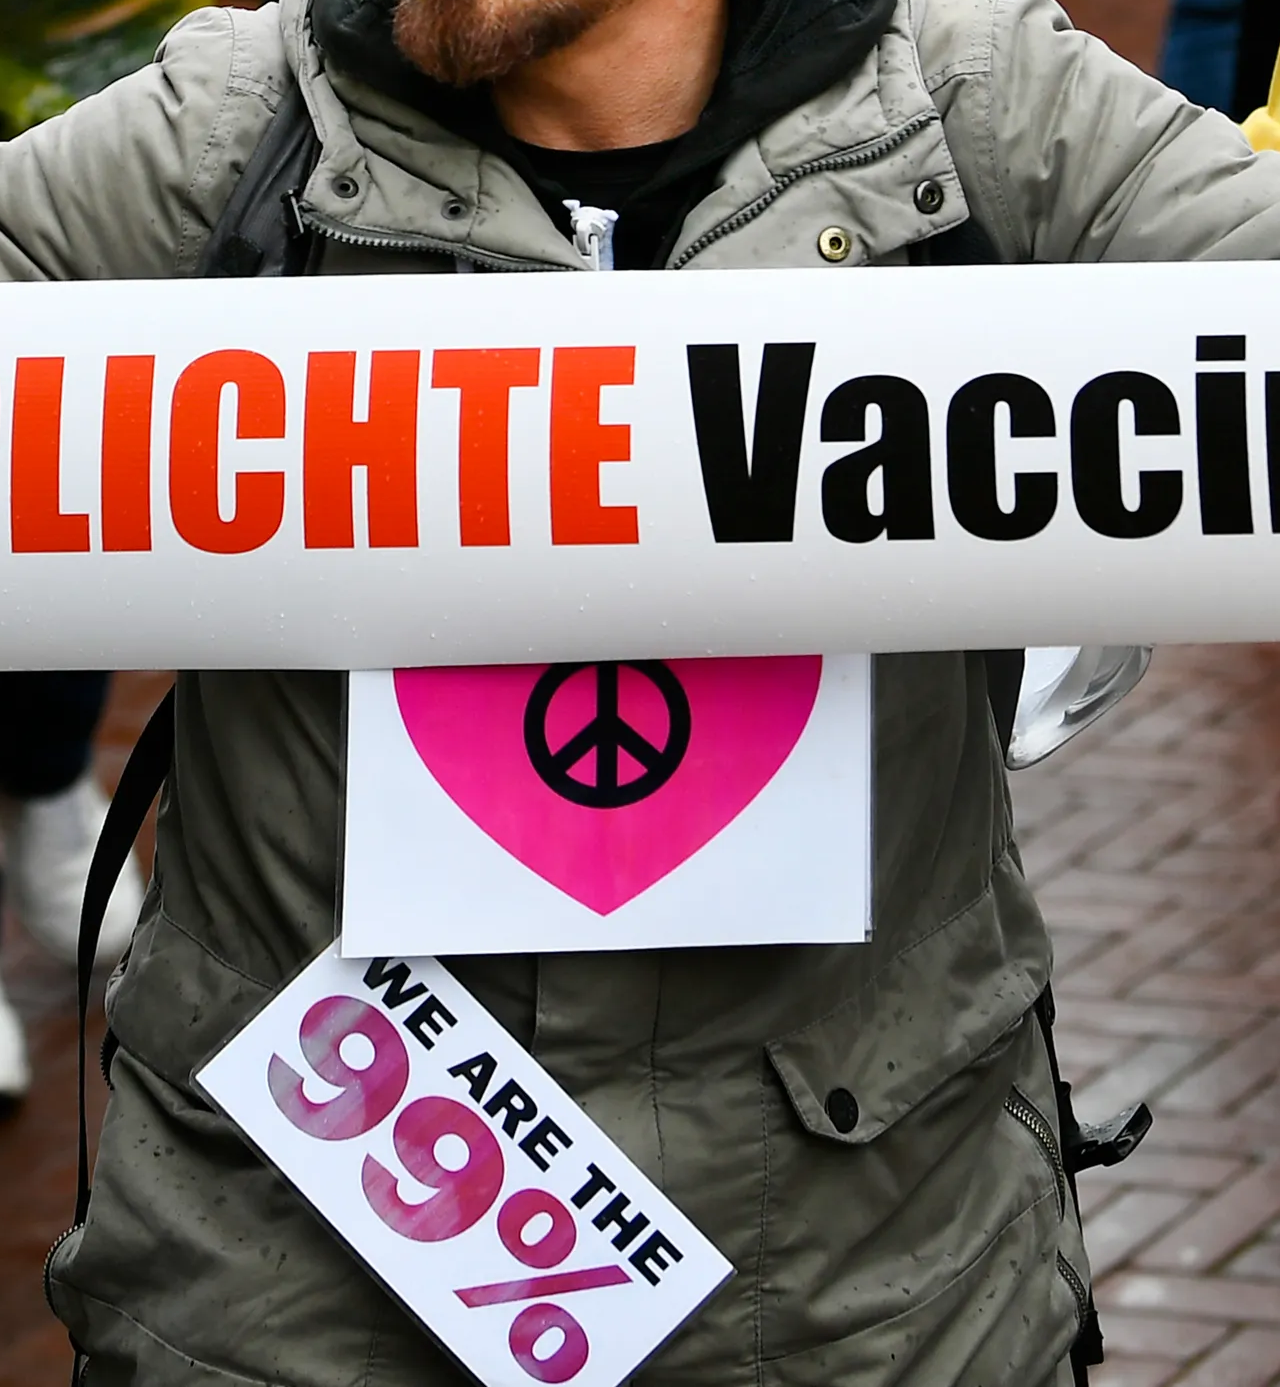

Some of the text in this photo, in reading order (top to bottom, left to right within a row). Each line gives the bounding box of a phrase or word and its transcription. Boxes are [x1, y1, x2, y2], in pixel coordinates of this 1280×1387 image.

[267, 994, 633, 1384] 99%
[363, 957, 685, 1287] WE ARE THE
